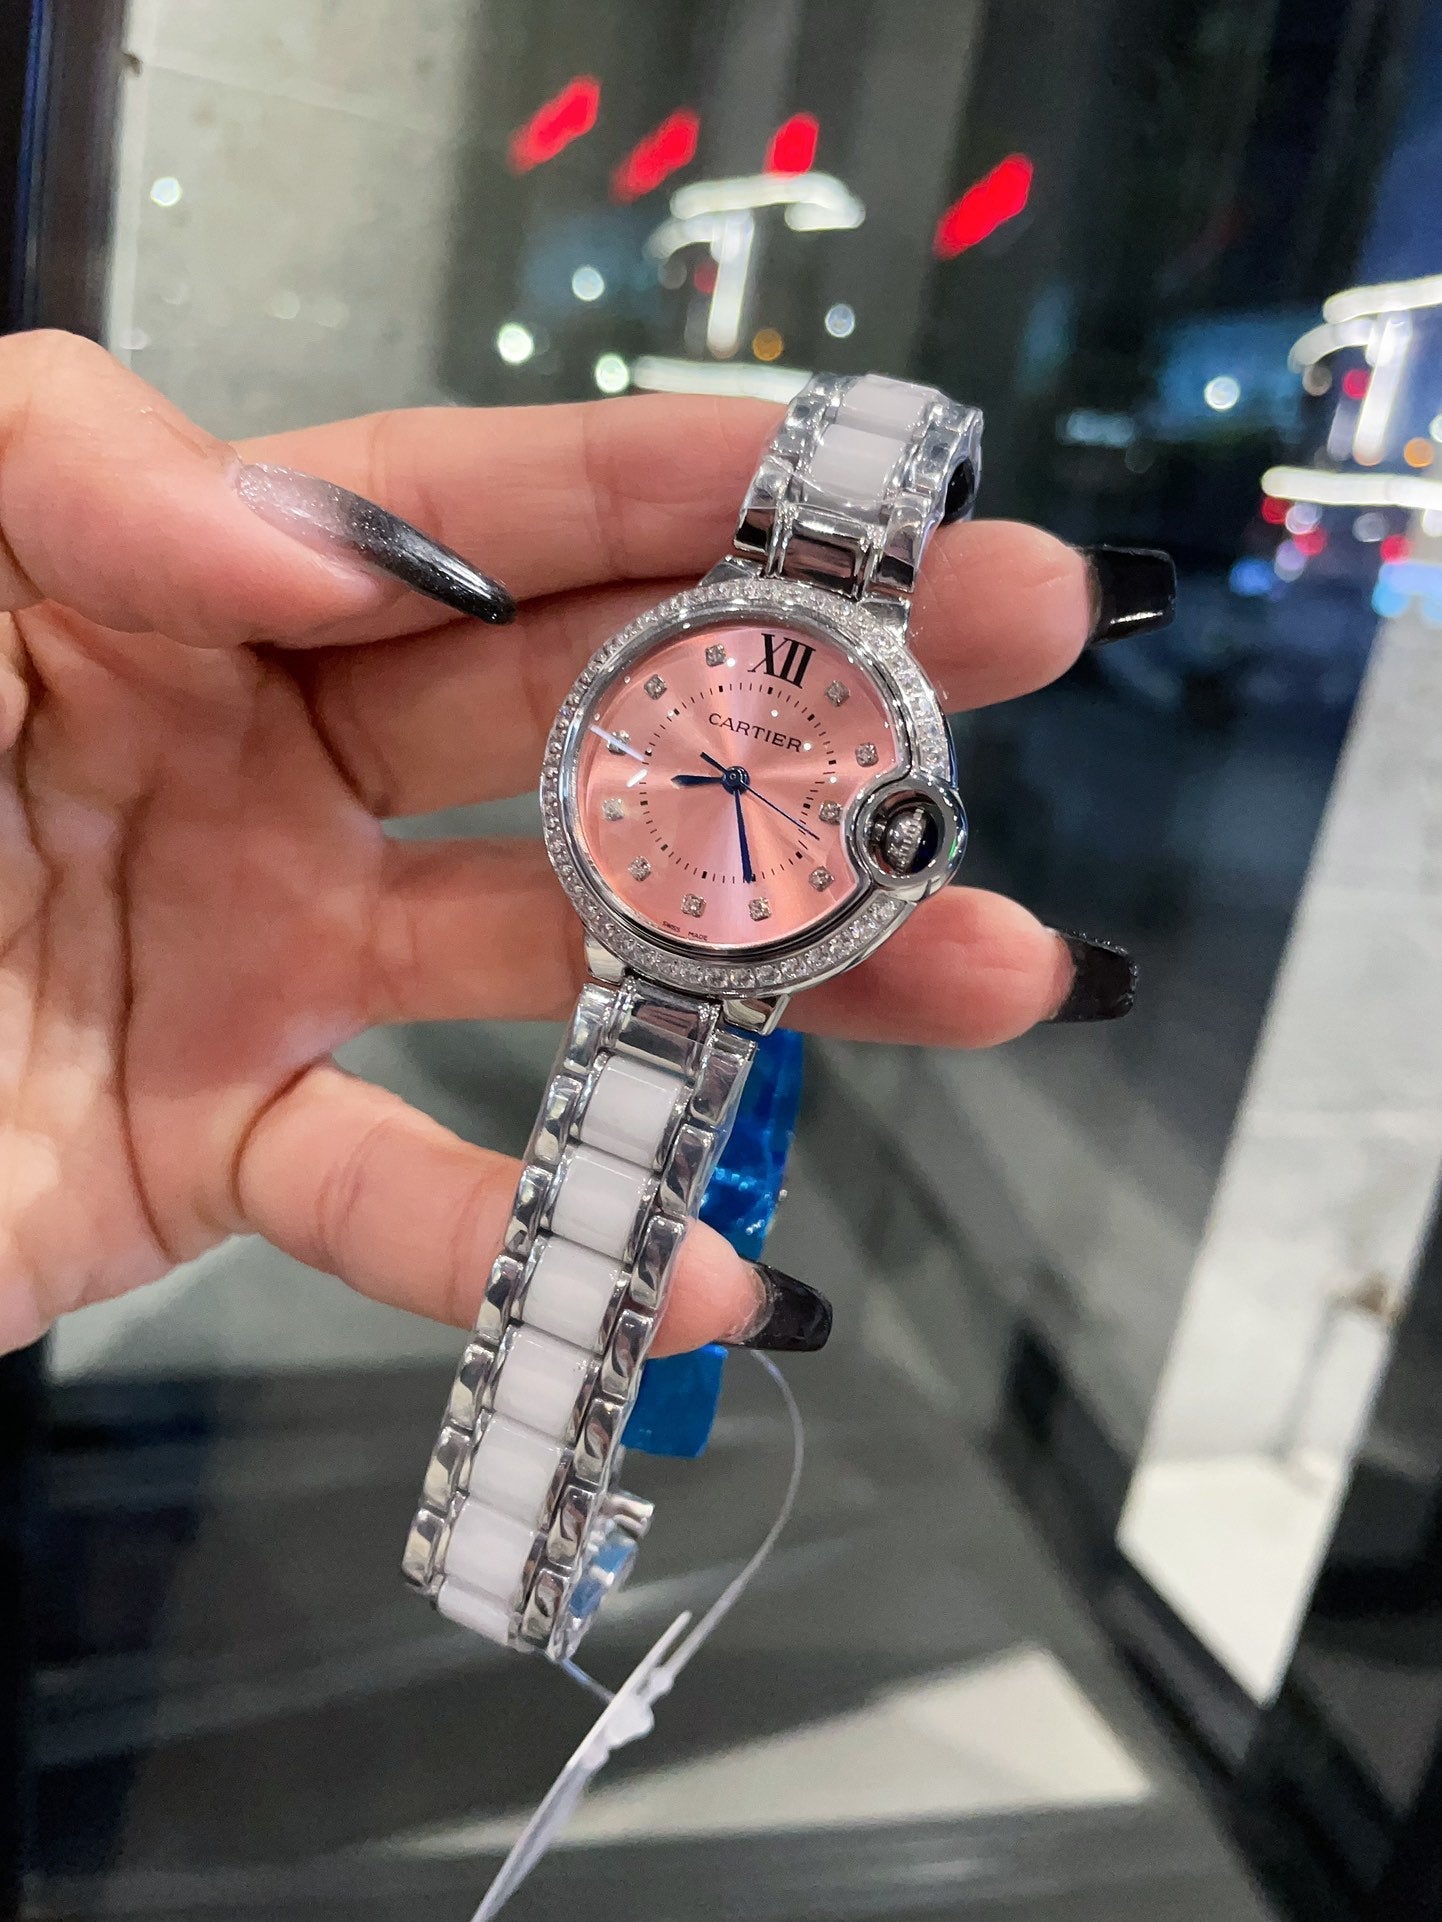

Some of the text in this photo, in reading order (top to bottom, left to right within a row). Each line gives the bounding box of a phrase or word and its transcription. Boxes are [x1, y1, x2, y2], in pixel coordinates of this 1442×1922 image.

[747, 632, 817, 690] XII
[708, 712, 803, 753] CARTIER
[687, 931, 708, 941] MADE
